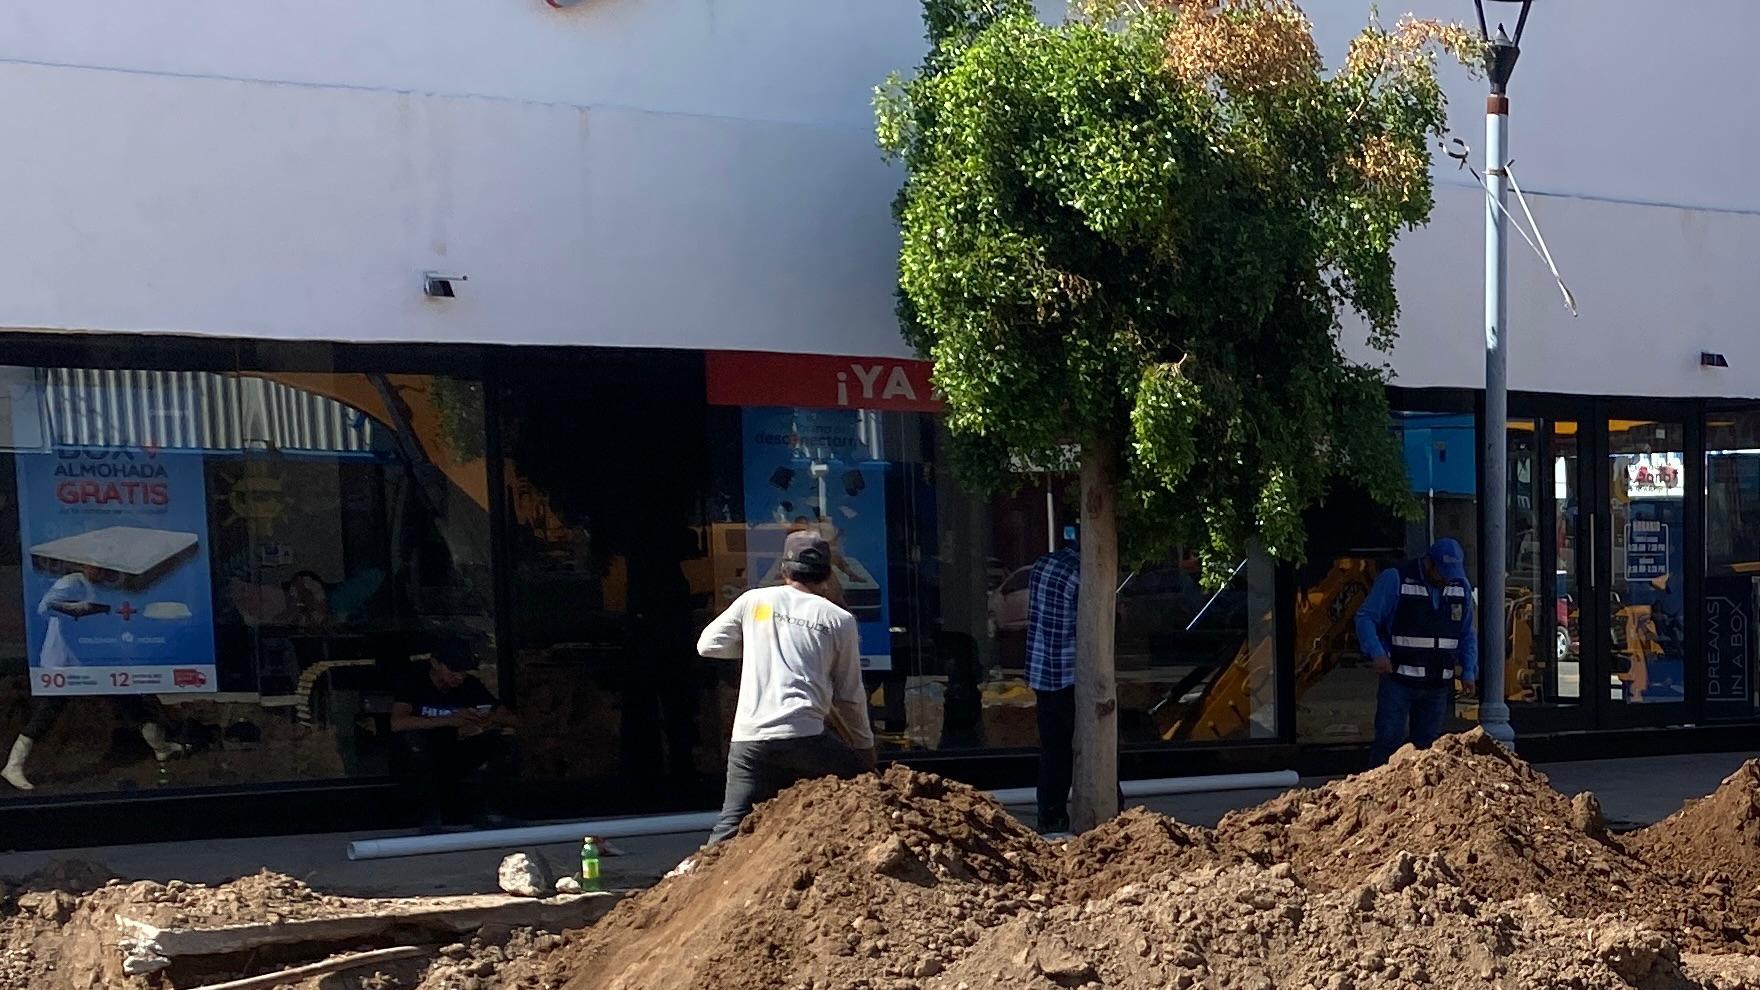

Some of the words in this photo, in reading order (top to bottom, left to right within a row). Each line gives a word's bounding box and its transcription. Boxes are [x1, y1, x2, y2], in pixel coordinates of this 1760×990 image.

[836, 363, 917, 406] ¡YA
[54, 463, 168, 478] ALMOHADA
[56, 481, 168, 505] GRATIS
[1730, 599, 1744, 648] BOX
[1707, 600, 1721, 695] DREAMS
[1731, 654, 1744, 669] A
[41, 673, 65, 688] 90
[110, 672, 129, 687] 12
[1731, 674, 1744, 695] IN
